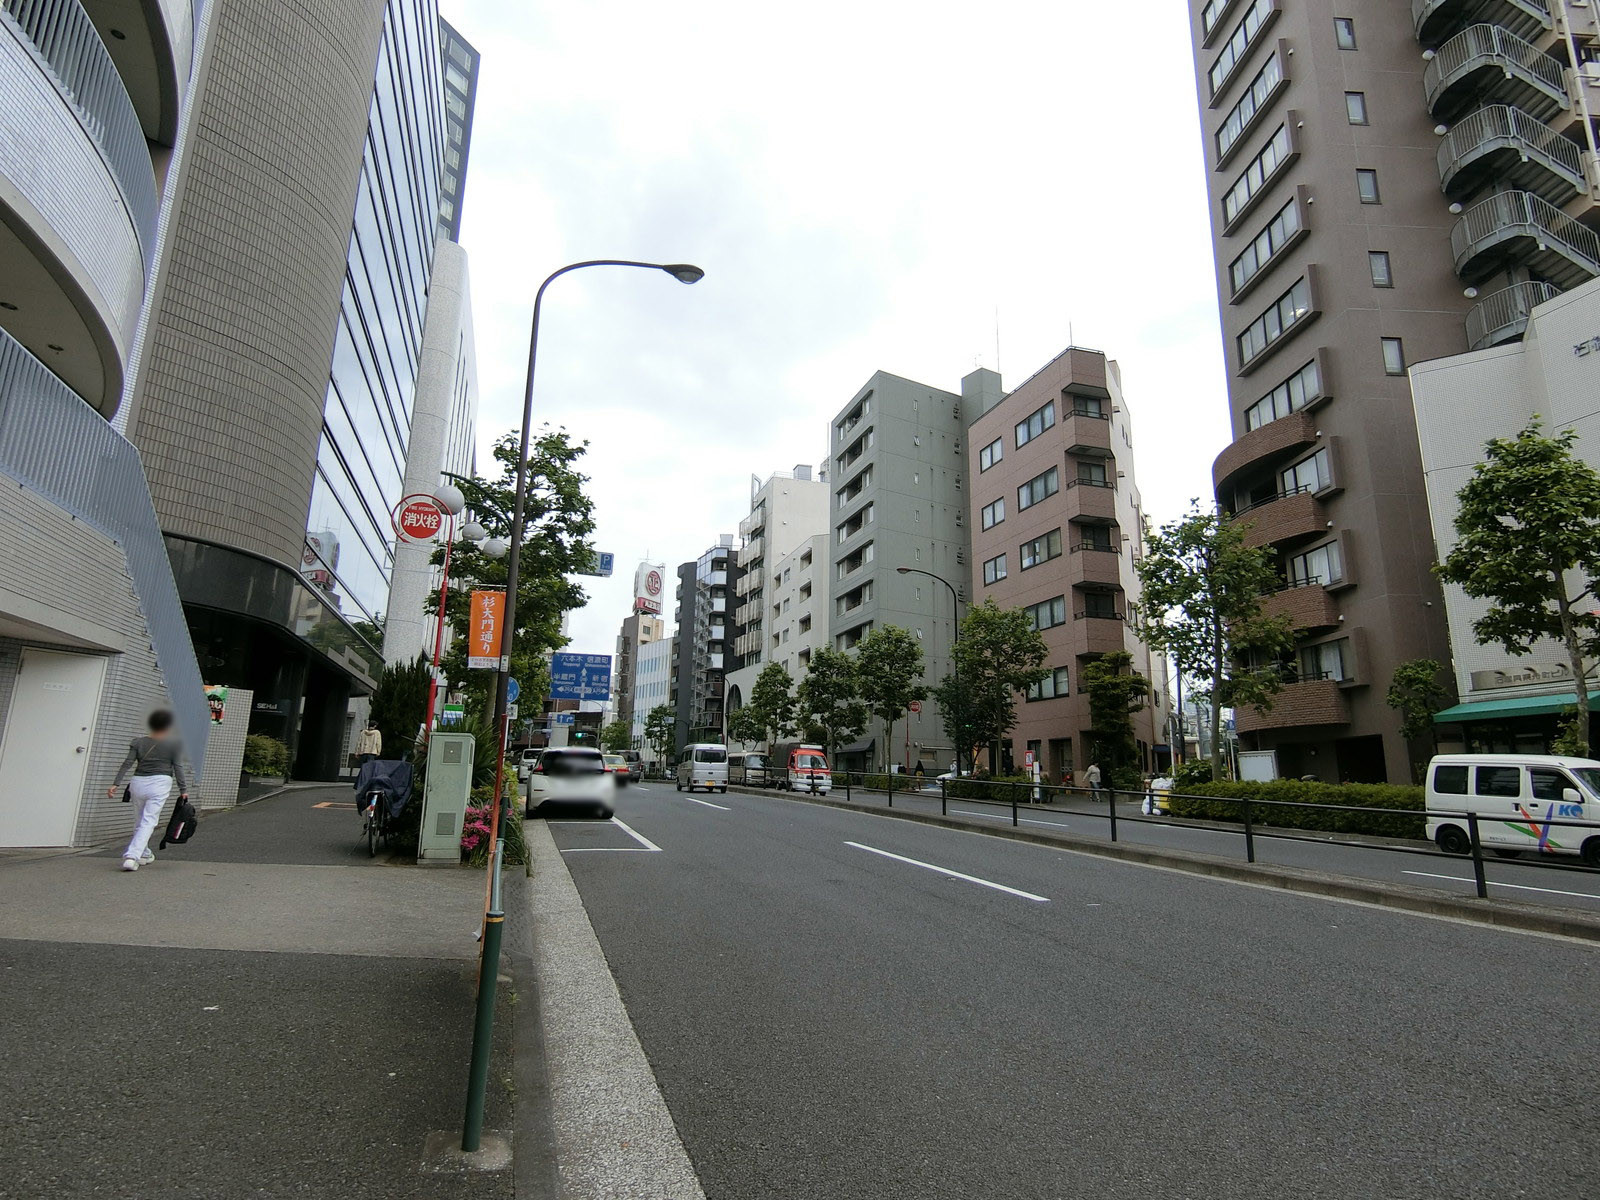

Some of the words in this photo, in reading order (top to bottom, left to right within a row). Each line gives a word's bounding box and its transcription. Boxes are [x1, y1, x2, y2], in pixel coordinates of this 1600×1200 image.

[404, 512, 439, 529] 消火栓
[603, 555, 610, 565] P
[480, 596, 496, 655] 杉大門通り
[587, 656, 609, 664] 信濃町
[553, 673, 576, 681] 半蔵門
[592, 674, 609, 682] 新宿
